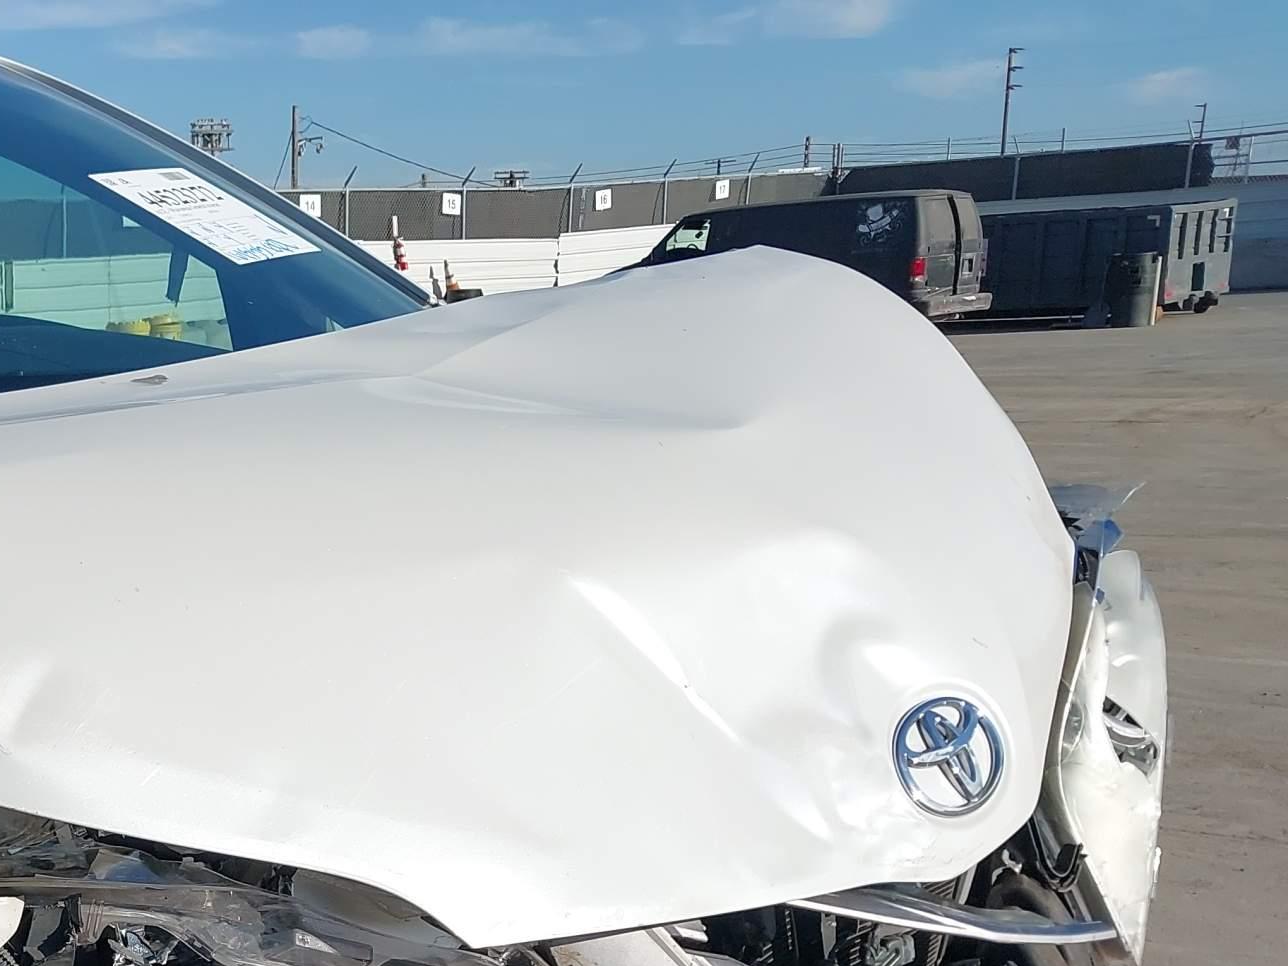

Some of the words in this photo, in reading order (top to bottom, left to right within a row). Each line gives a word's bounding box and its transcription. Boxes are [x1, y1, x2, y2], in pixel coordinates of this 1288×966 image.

[137, 186, 225, 208] 44523272
[601, 193, 609, 205] 16
[305, 200, 315, 212] 14
[448, 197, 456, 210] 15
